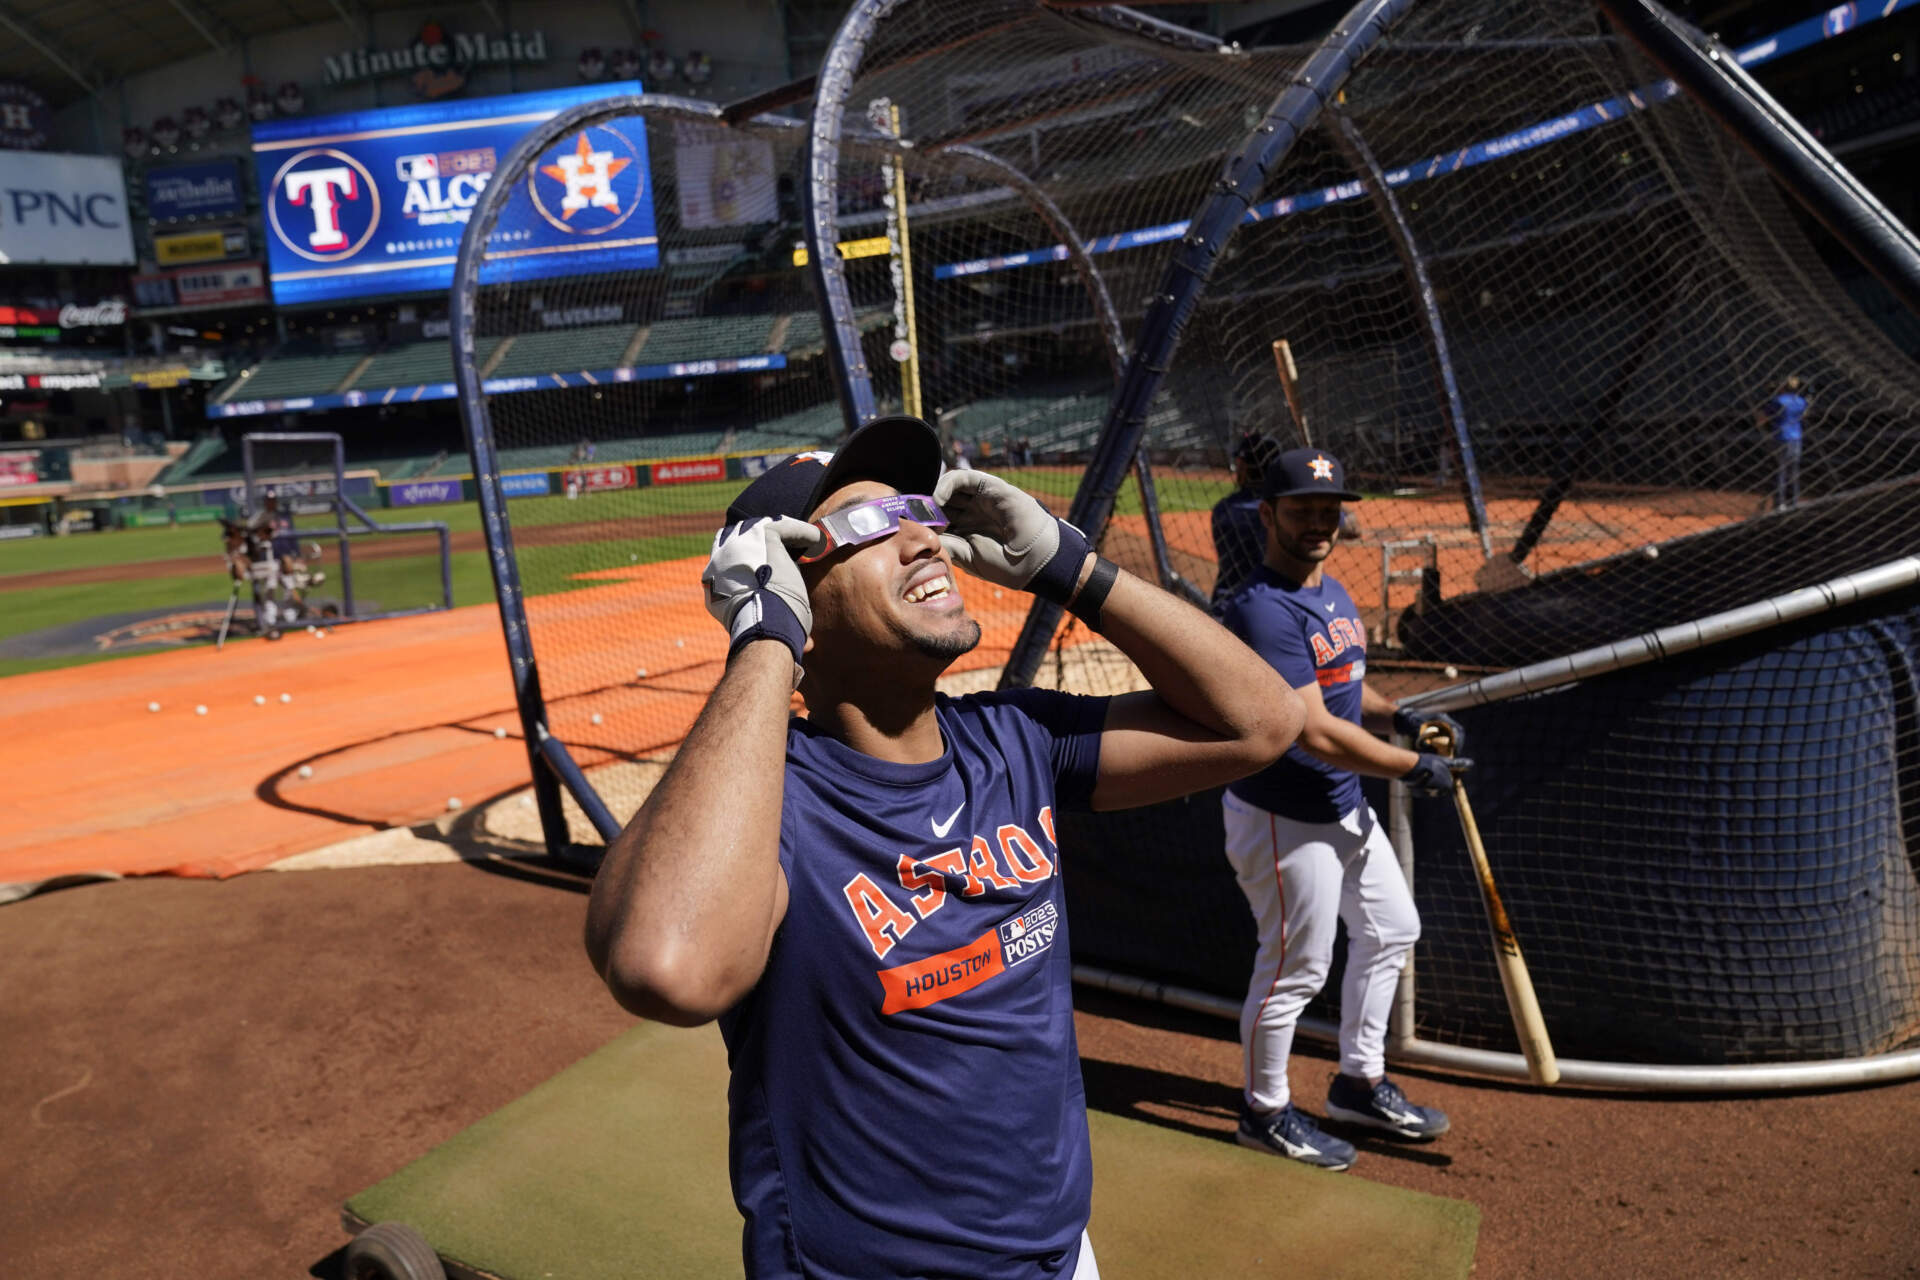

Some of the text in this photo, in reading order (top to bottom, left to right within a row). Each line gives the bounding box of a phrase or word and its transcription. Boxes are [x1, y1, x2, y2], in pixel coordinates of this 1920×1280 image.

[322, 40, 450, 85] Minute
[453, 31, 547, 63] Maid
[4, 187, 120, 229] PNC
[284, 166, 359, 252] T
[1025, 904, 1056, 928] 2023
[1004, 917, 1059, 963] POSTS
[905, 948, 992, 997] HOUSTON
